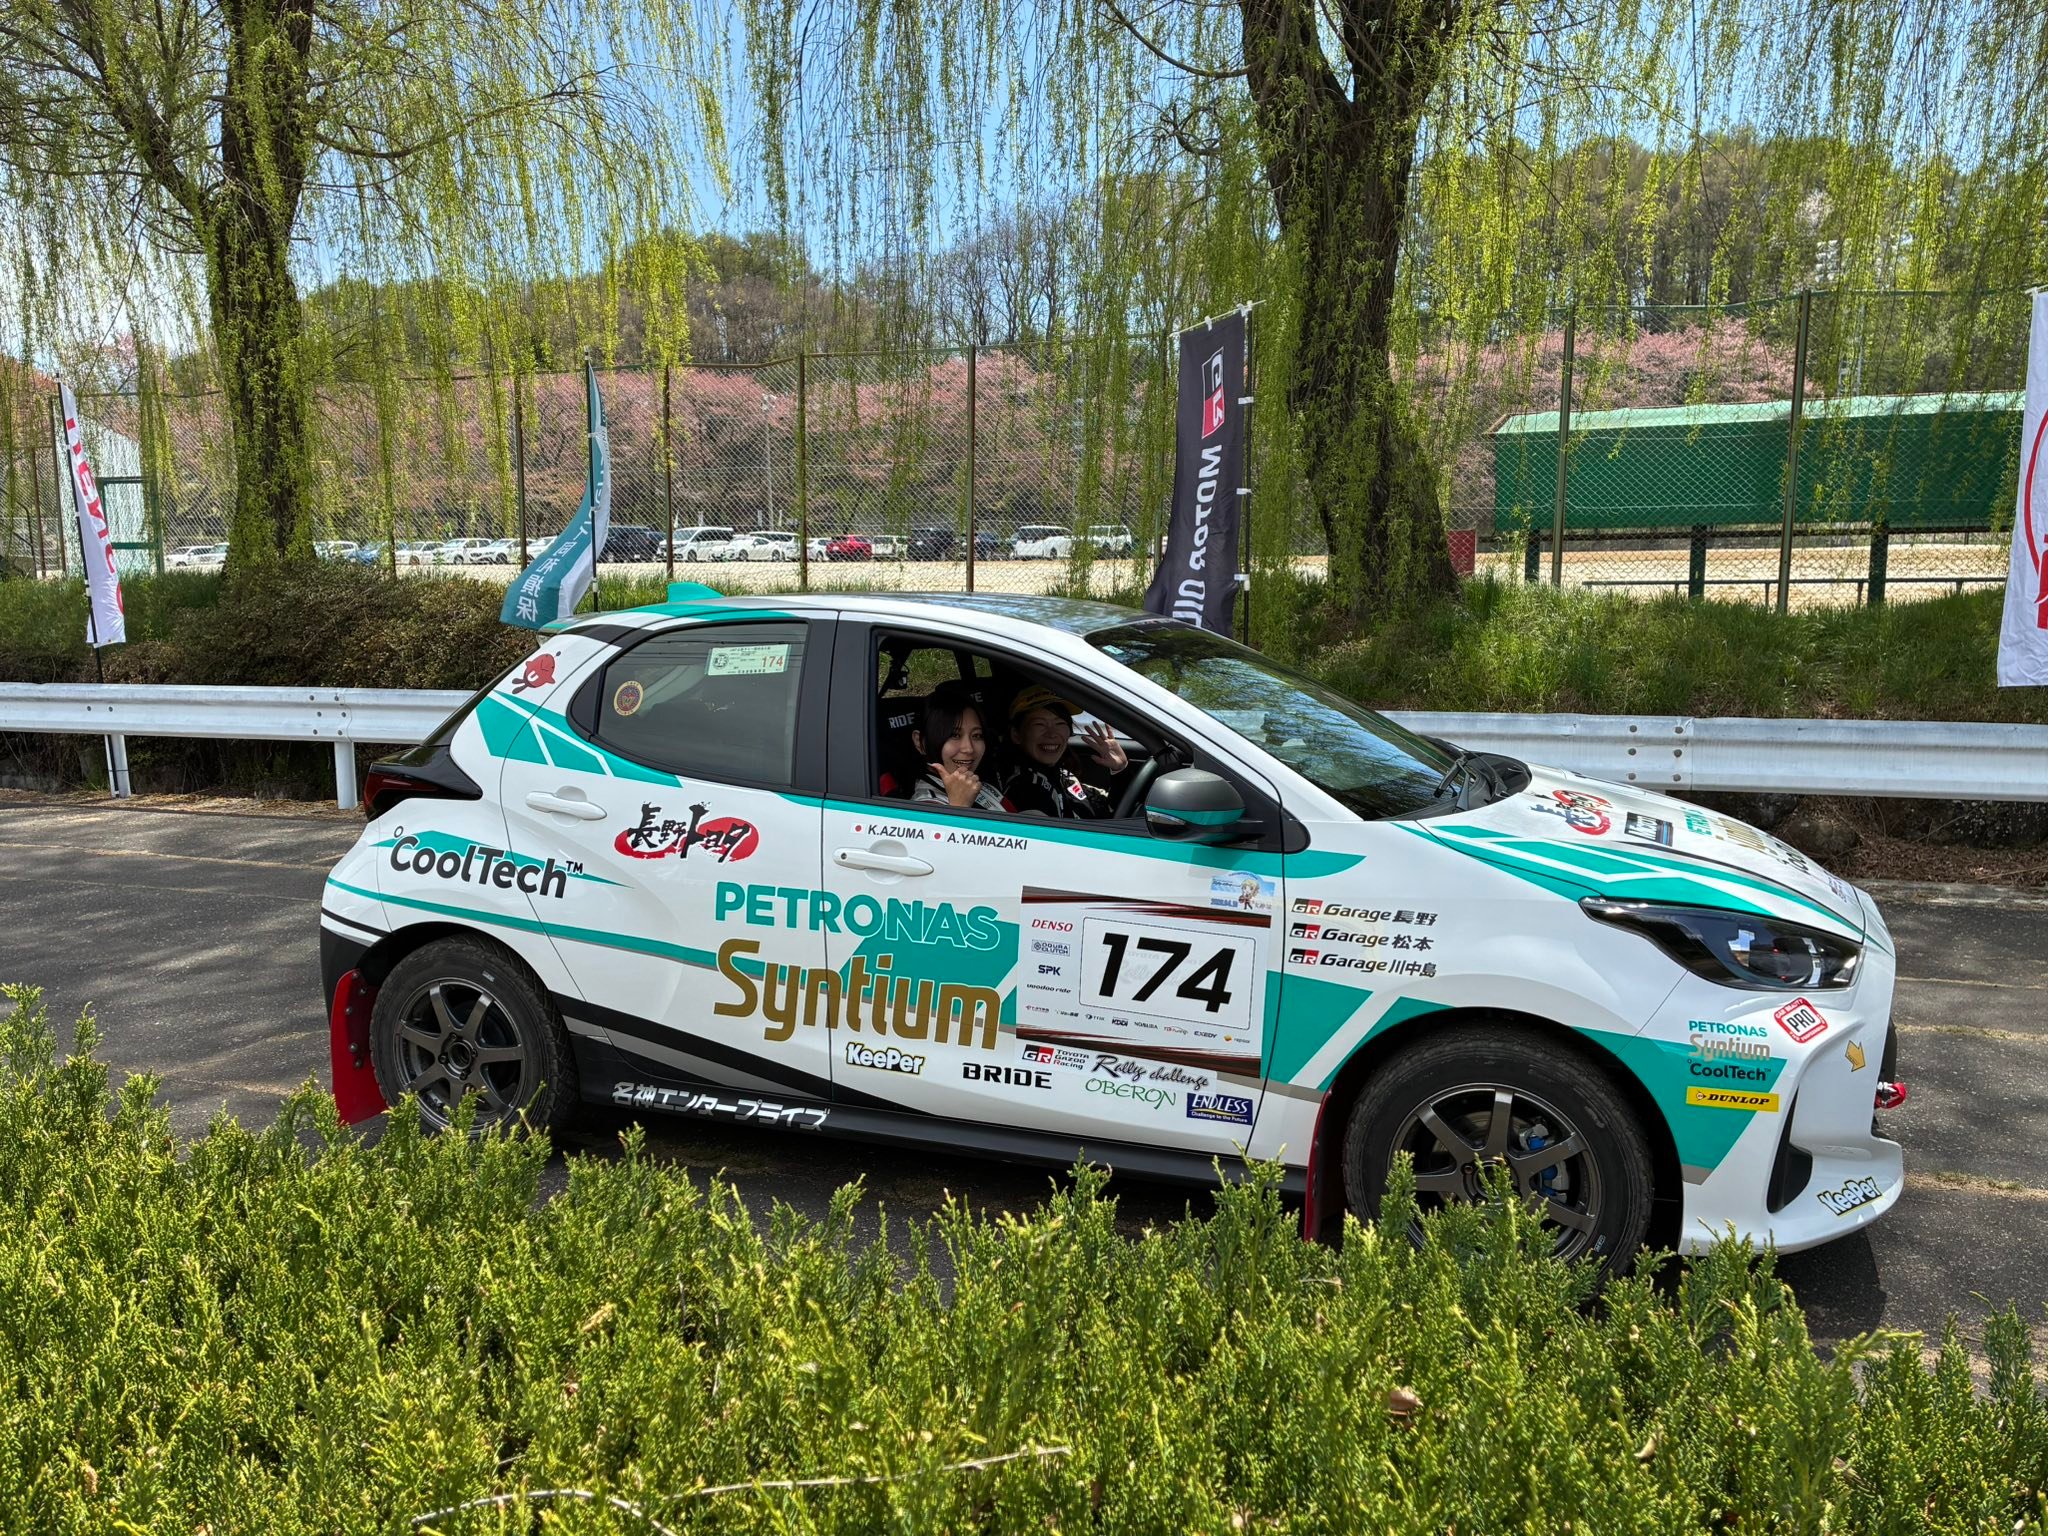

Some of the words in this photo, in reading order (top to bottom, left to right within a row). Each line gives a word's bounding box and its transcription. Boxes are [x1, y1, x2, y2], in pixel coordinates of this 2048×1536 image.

[762, 655, 784, 668] 174
[888, 712, 916, 729] RIDE
[627, 801, 750, 863] 長野トヨタ
[868, 824, 925, 840] K.AZUMA
[947, 832, 1028, 851] A.YAMAZAKI
[714, 880, 1001, 951] PETRONAS
[1031, 918, 1074, 933] DENSO
[1292, 902, 1322, 915] GR
[1323, 904, 1392, 922] Garage
[1392, 910, 1438, 927] 長野
[1290, 926, 1320, 940] GR
[1321, 928, 1389, 947] Garage
[1392, 934, 1434, 951] 松本
[1038, 964, 1061, 976] SPK
[1098, 932, 1237, 1014] 174
[1289, 951, 1319, 965] GR
[1320, 953, 1388, 972] Garage
[1388, 959, 1437, 978] 川中島
[713, 938, 1002, 1051] Syntium
[1689, 1020, 1768, 1037] PETRONAS
[1786, 1009, 1816, 1033] PRO
[1194, 1030, 1218, 1039] EXEDY
[1023, 1048, 1053, 1064] GR
[1054, 1055, 1086, 1064] GAZOO
[1056, 1049, 1090, 1059] TOYOTA
[1688, 1033, 1770, 1062] Syntium
[846, 1042, 925, 1075] KeePer
[963, 1062, 1052, 1089] BRIDE
[1053, 1060, 1083, 1070] Racing
[1091, 1054, 1147, 1081] Rally
[1150, 1066, 1210, 1090] challenge
[612, 1081, 831, 1131] 名神エンタープライズ
[1085, 1078, 1177, 1110] OBERON
[1191, 1094, 1249, 1114] ENDLESS
[1708, 1093, 1770, 1105] DUNLOP
[1817, 1176, 1883, 1216] KeePer
